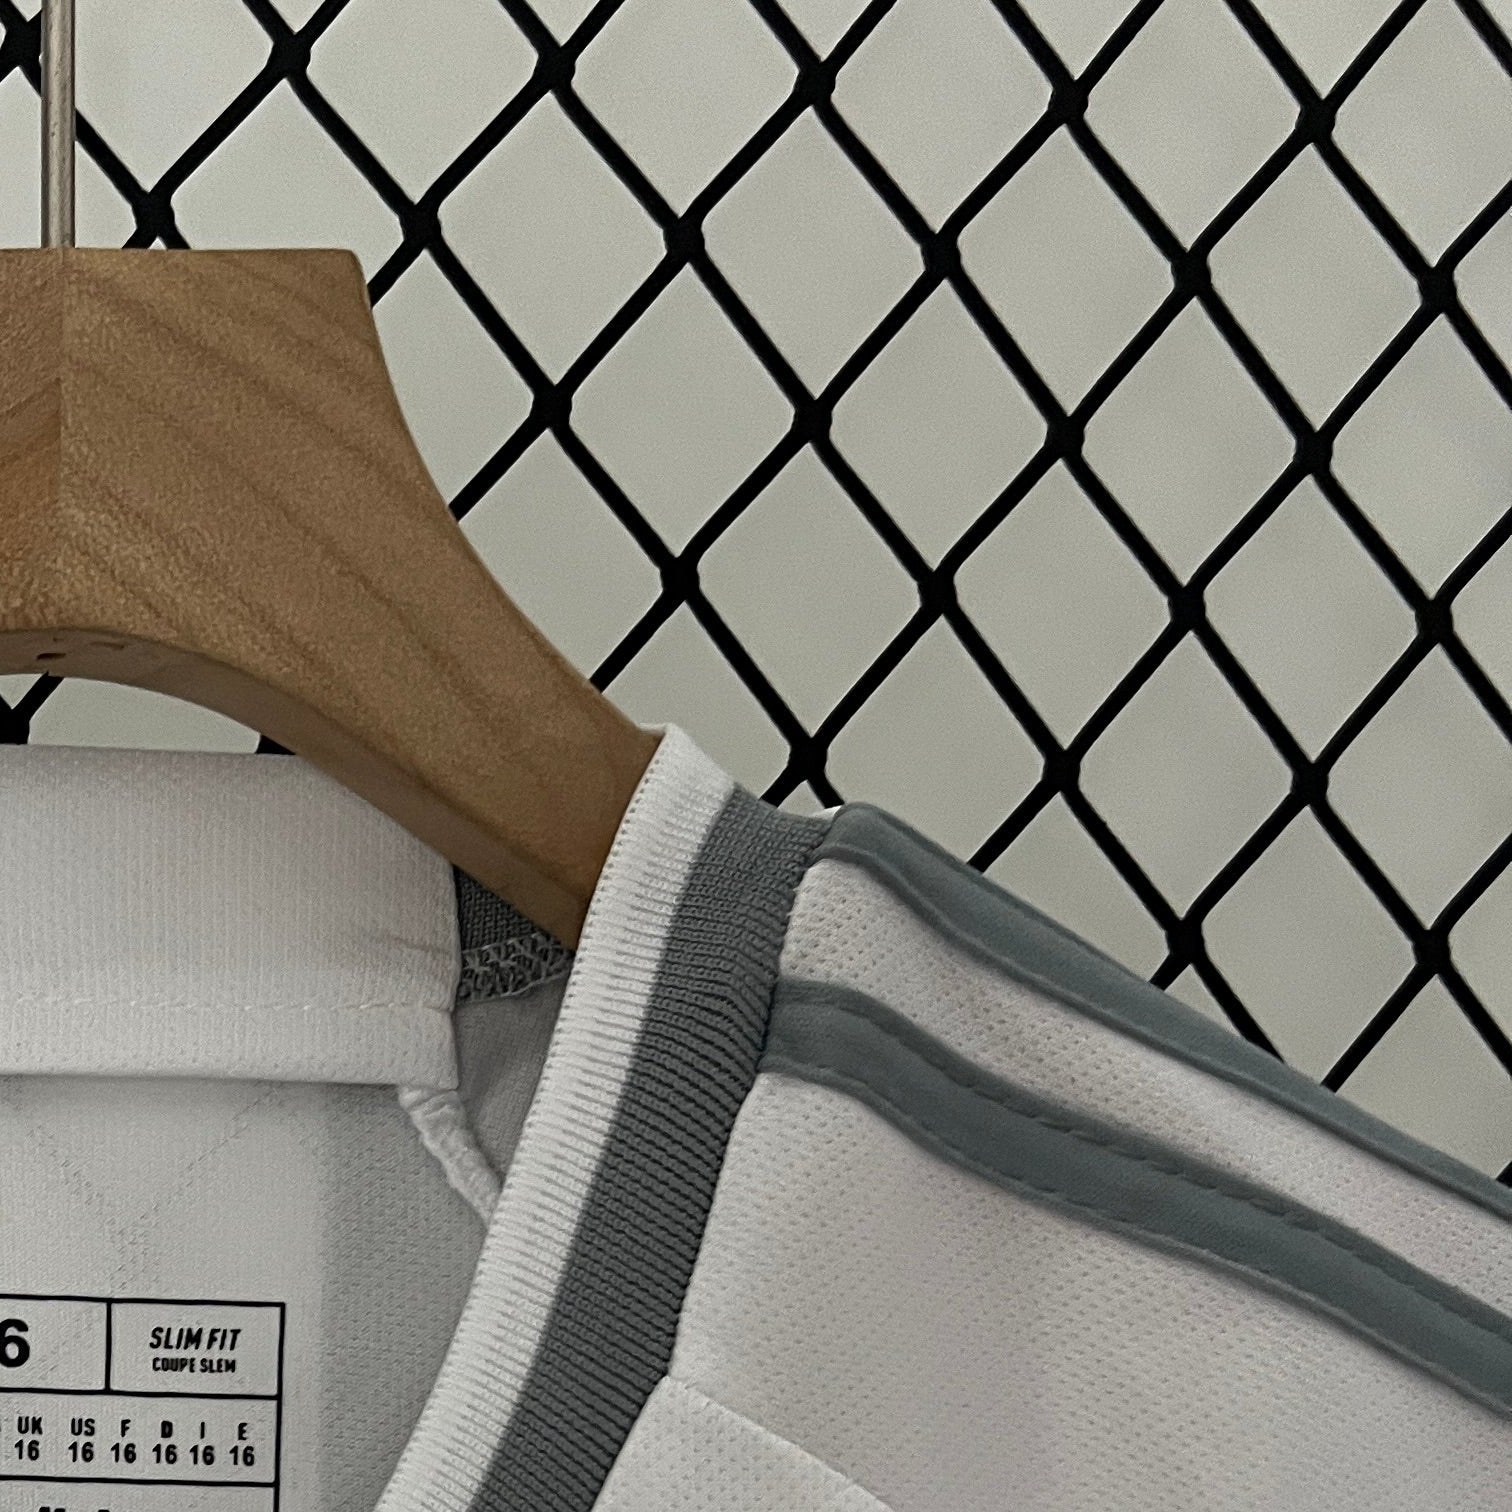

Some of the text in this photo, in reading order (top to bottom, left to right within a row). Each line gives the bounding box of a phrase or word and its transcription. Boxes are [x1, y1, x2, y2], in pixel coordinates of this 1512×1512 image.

[149, 1327, 241, 1351] SLIM FIT
[153, 1357, 195, 1373] COUPE
[18, 1416, 43, 1435] UK
[71, 1418, 95, 1436] US
[121, 1419, 131, 1437] F
[161, 1421, 173, 1438] D
[200, 1422, 205, 1439] I
[238, 1423, 248, 1441] E
[15, 1439, 39, 1461] 16
[68, 1441, 94, 1462] 16
[111, 1443, 136, 1464] 16
[152, 1444, 177, 1464] 16
[190, 1445, 215, 1465] 16
[229, 1445, 255, 1466] 16
